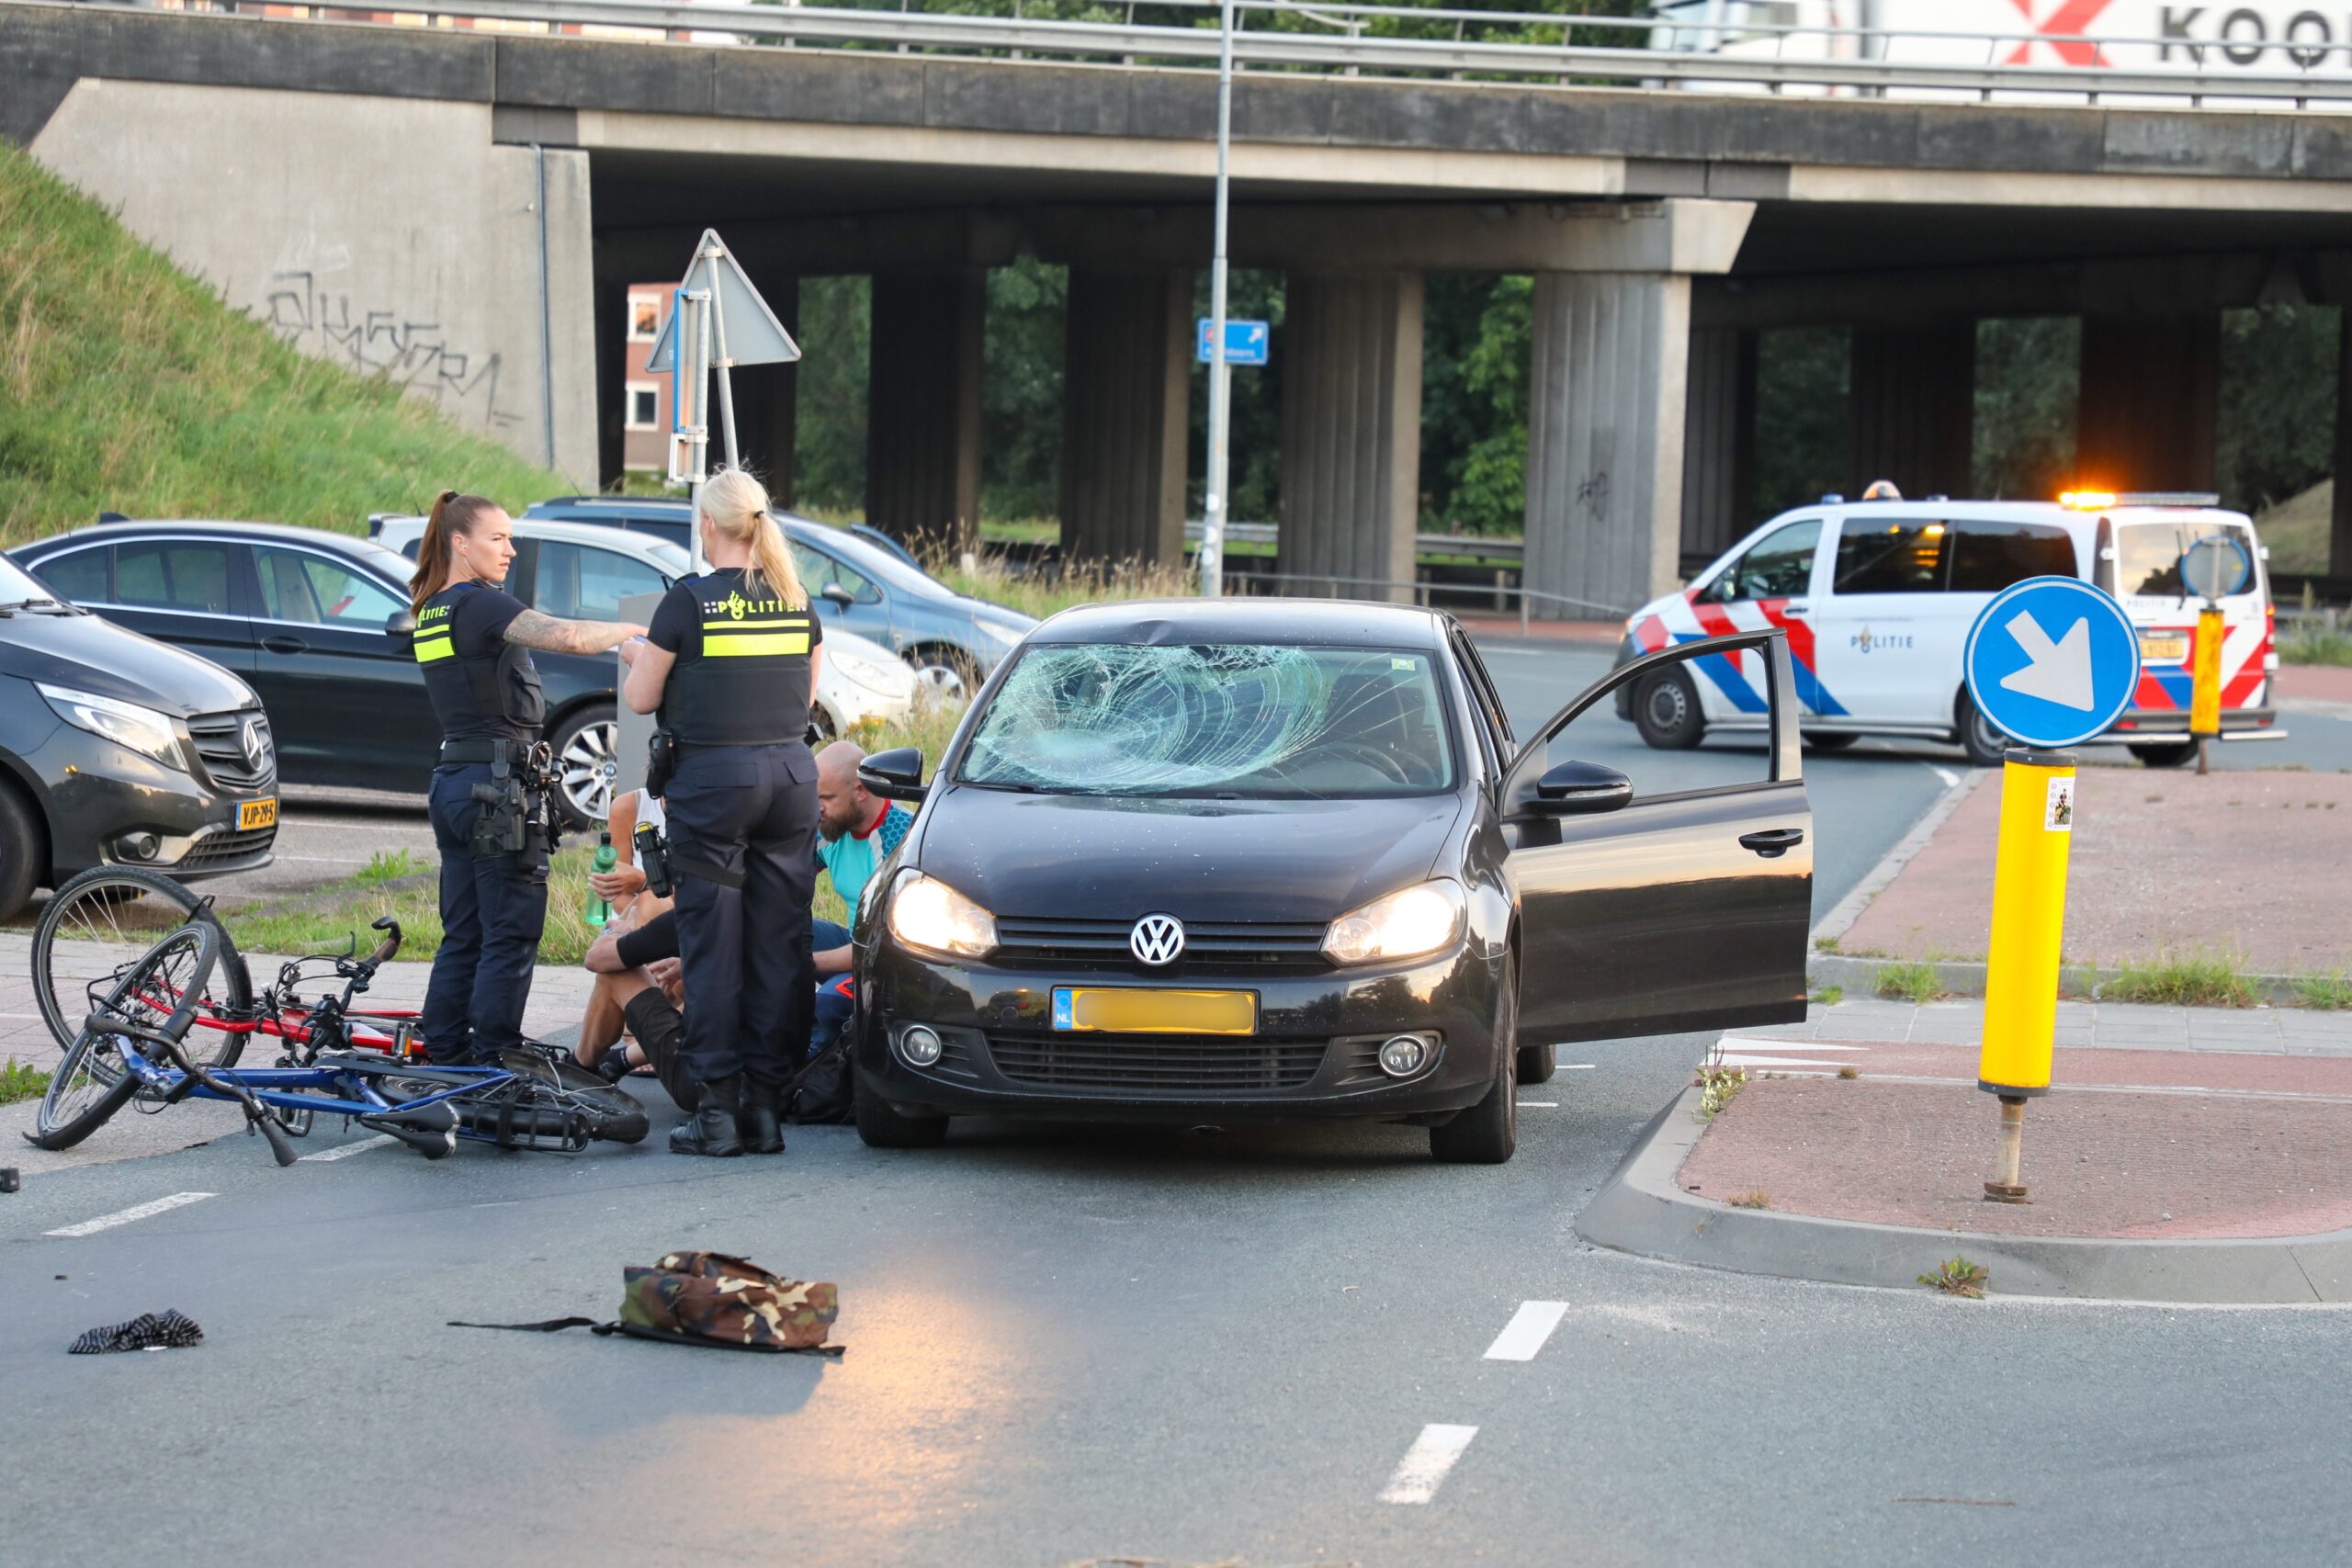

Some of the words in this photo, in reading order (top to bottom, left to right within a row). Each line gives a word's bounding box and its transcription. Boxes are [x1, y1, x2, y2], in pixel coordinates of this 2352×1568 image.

[2160, 6, 2352, 69] KOO
[1851, 630, 1913, 653] POLITIE
[1057, 1013, 1070, 1023] NL
